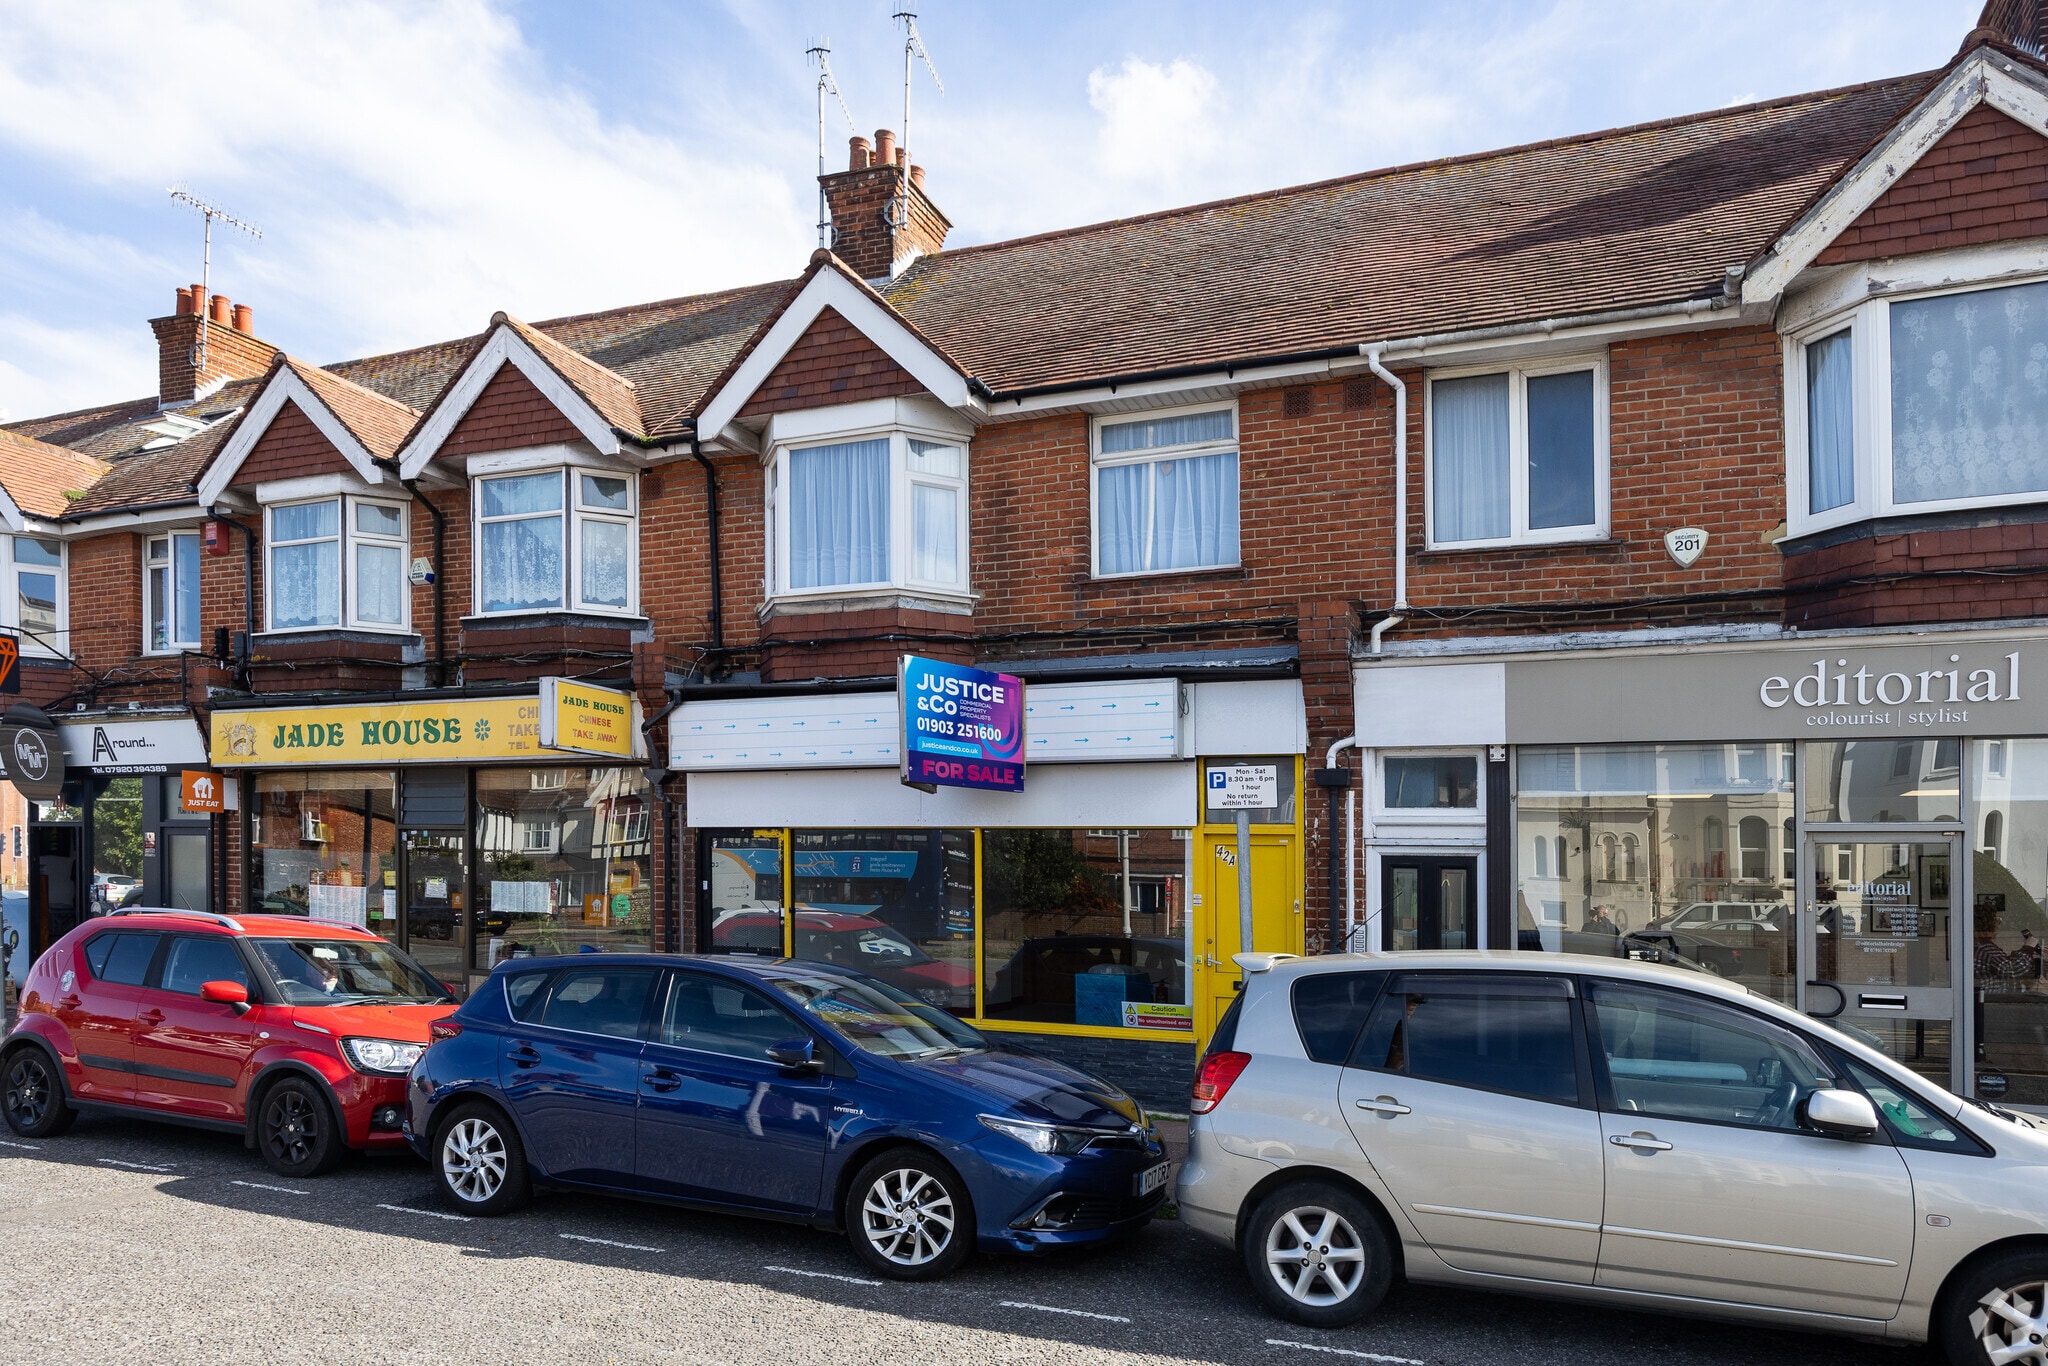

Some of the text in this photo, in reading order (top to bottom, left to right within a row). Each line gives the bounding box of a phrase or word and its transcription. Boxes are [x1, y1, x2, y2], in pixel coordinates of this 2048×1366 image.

[1675, 539, 1700, 551] 201
[1759, 651, 2021, 708] editorial
[916, 673, 1005, 704] JUSTICE
[562, 696, 625, 714] JADE HOUSE
[959, 699, 993, 710] COMMERCIAL
[959, 705, 987, 714] PROPERTY
[518, 706, 540, 719] CHI
[959, 711, 992, 721] SPECIALISTS
[1806, 711, 1891, 727] colourist
[1908, 708, 1969, 728] stylist
[578, 715, 612, 728] CHINESE
[273, 717, 462, 749] JADE HOUSE
[507, 724, 540, 737] TAKE
[572, 729, 618, 743] TAKE AWAY
[917, 717, 1002, 742] 01903 251600
[508, 741, 530, 750] TEL
[921, 740, 979, 755] justiceandco.co.uk
[105, 766, 132, 774] 07920
[133, 765, 167, 773] 394389
[922, 760, 1015, 785] FOR SALE
[1213, 774, 1224, 788] P
[187, 799, 205, 807] JUST
[1216, 846, 1236, 866] 42A
[1847, 880, 1911, 896] editorial
